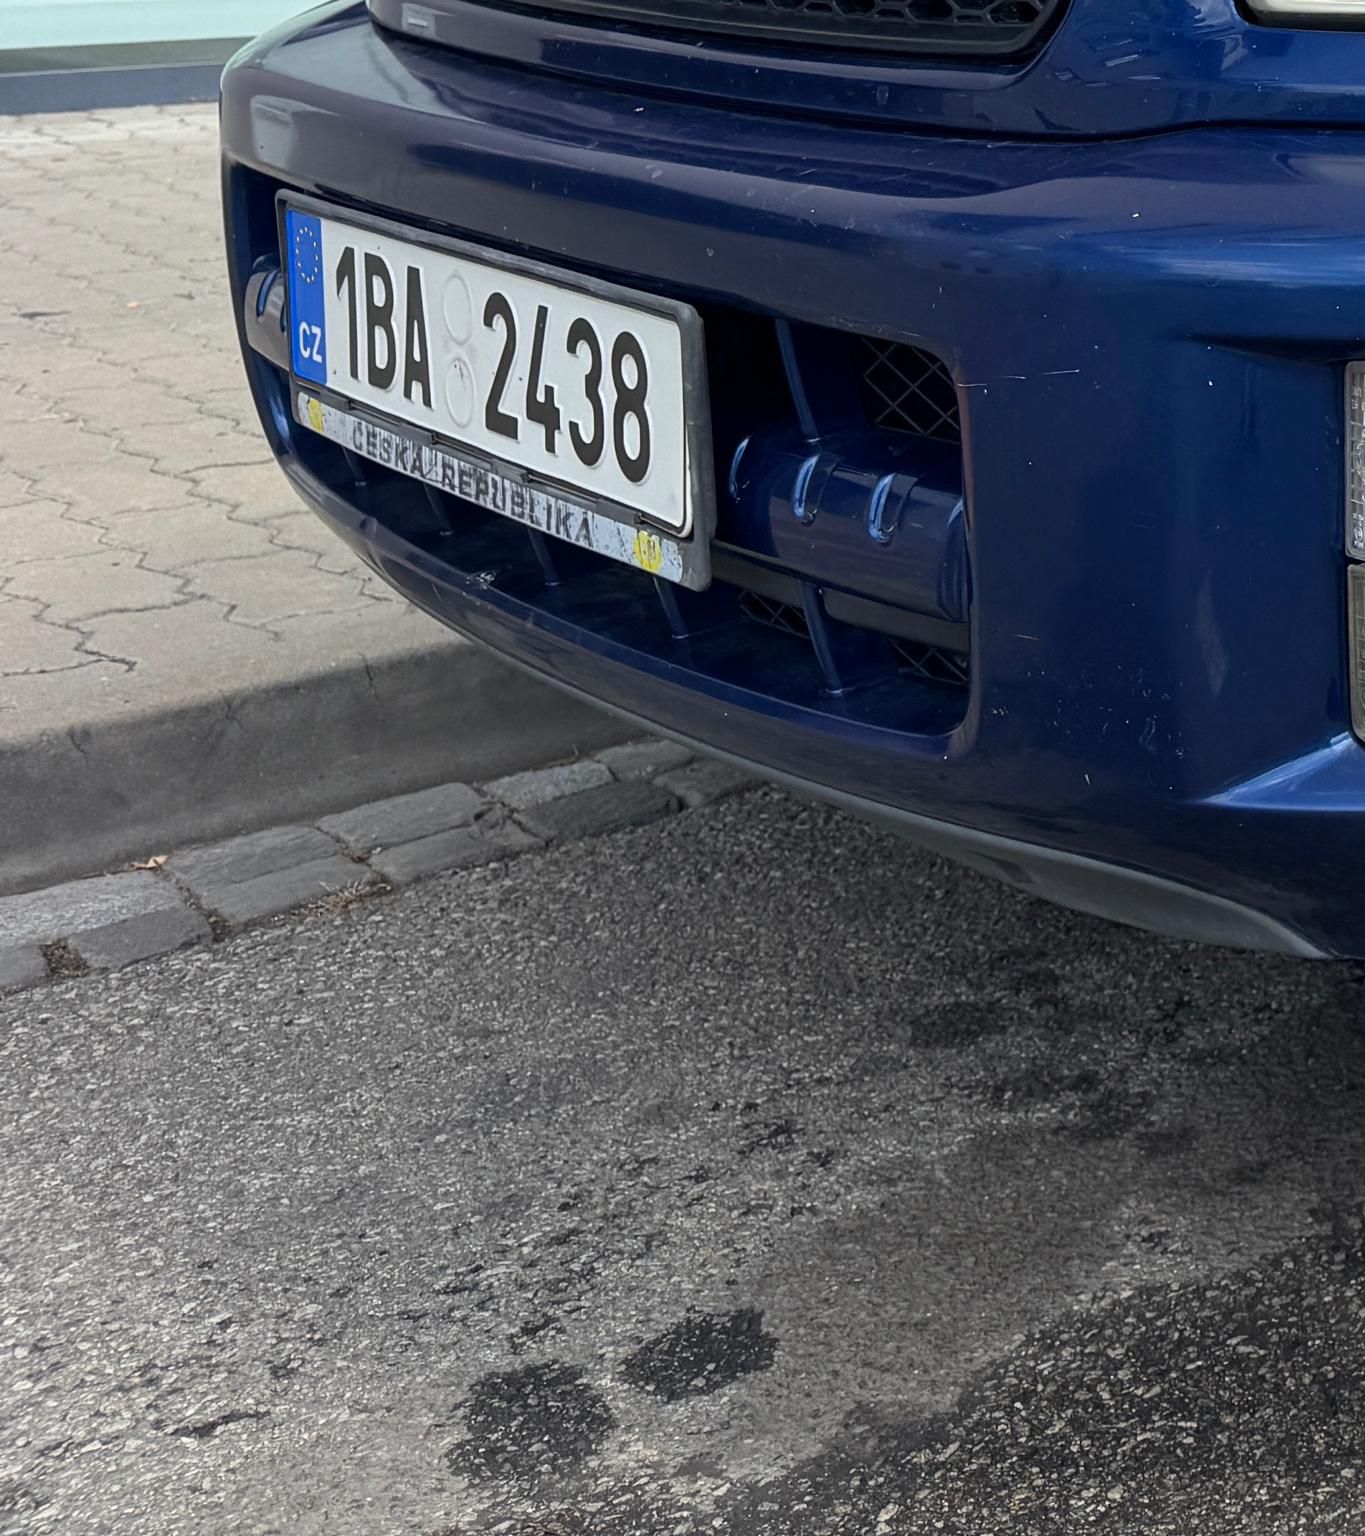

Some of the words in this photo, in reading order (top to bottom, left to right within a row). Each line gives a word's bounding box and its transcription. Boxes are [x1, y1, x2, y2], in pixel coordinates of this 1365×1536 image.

[298, 321, 323, 364] CZ
[335, 245, 433, 409] 1BA
[482, 291, 651, 484] 2438
